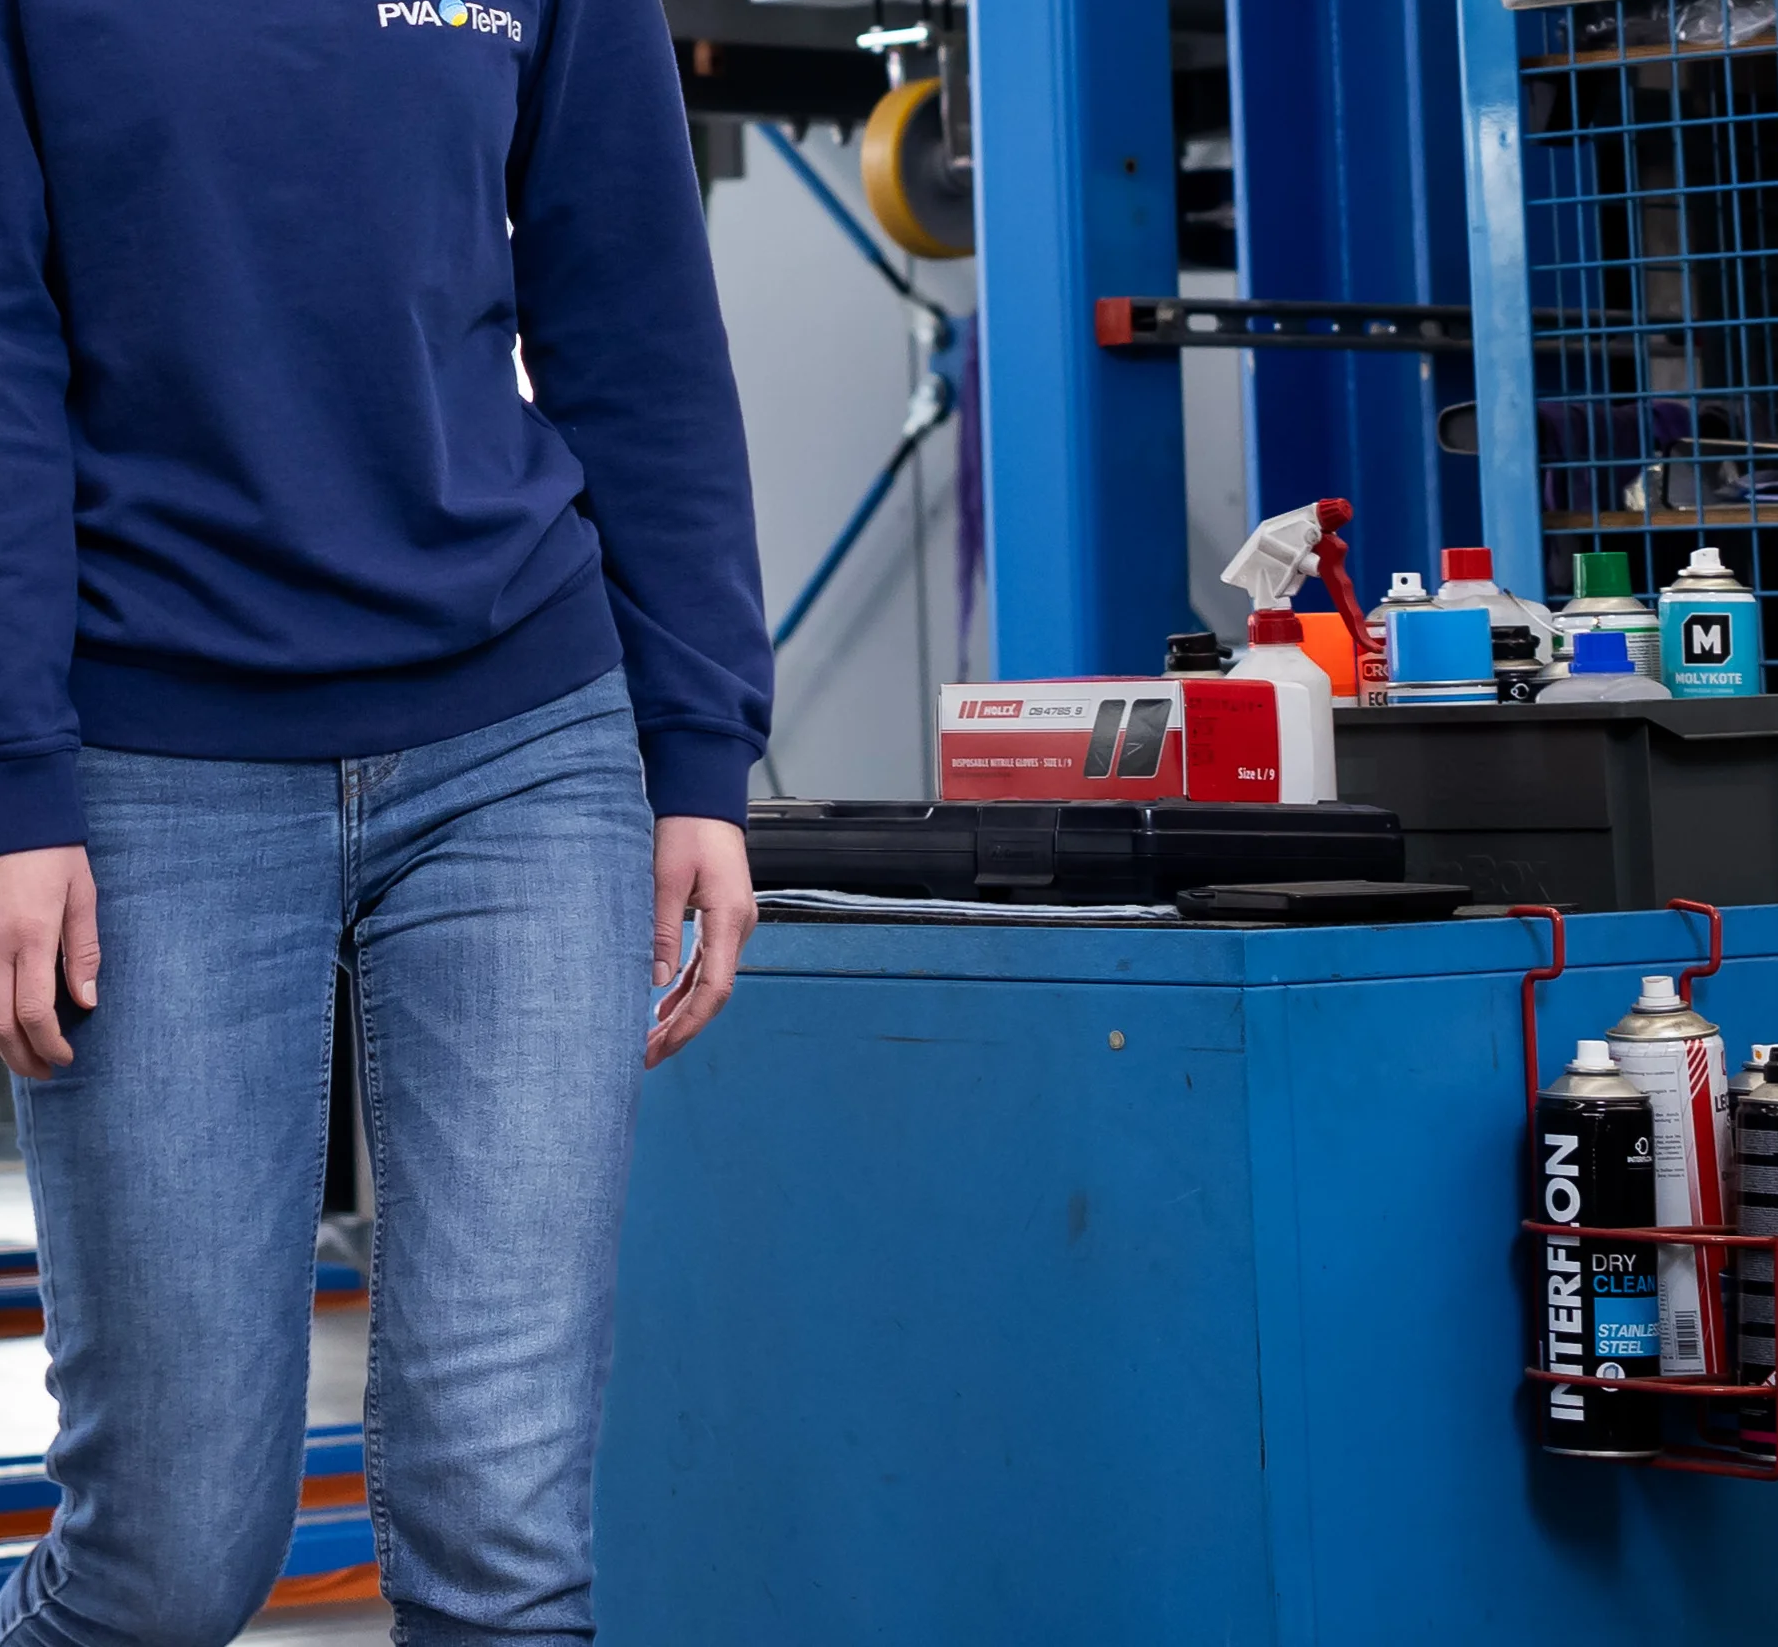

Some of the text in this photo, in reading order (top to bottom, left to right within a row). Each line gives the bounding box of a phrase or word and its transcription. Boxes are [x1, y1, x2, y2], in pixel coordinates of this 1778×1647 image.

[377, 0, 522, 42] PVA TePla
[1675, 672, 1743, 684] MOLYKOTE
[983, 703, 1016, 716] HOLEX
[951, 758, 989, 768] DISPOSABLE
[990, 758, 1014, 768] NITRILE
[1015, 758, 1039, 768] GLOVES
[1237, 767, 1256, 780] Size
[1592, 1254, 1637, 1272] DRY
[1544, 1133, 1585, 1422] INTERFLON
[1593, 1274, 1656, 1294] CLEAN
[1598, 1340, 1644, 1354] STEEL
